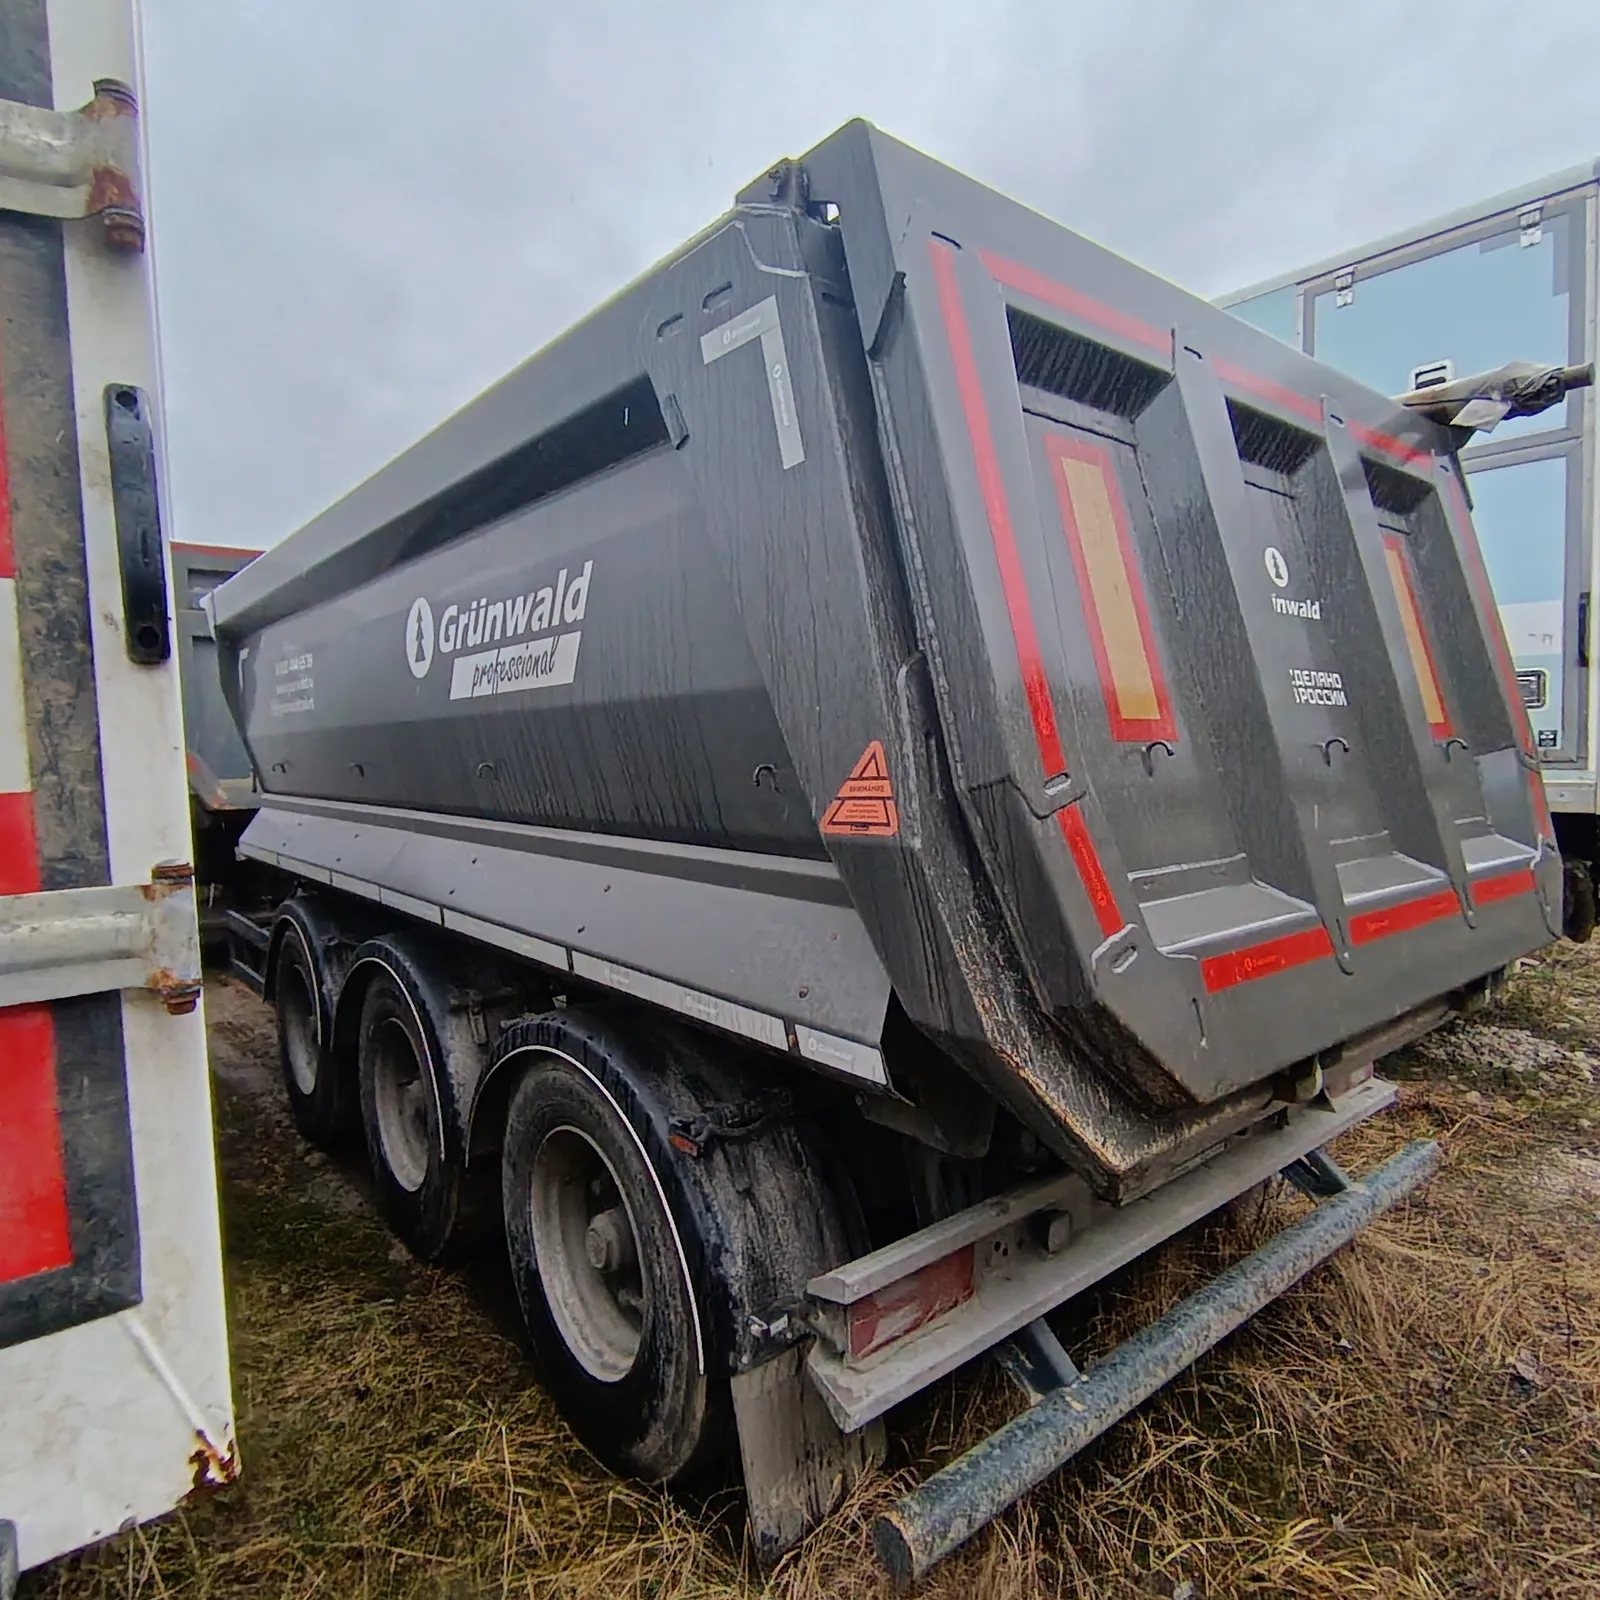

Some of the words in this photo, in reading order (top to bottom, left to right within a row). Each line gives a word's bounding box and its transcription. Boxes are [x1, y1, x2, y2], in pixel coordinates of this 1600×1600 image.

[438, 559, 594, 654] Grünwald
[470, 634, 560, 698] professional
[1289, 668, 1342, 689] ДЕЛАНО
